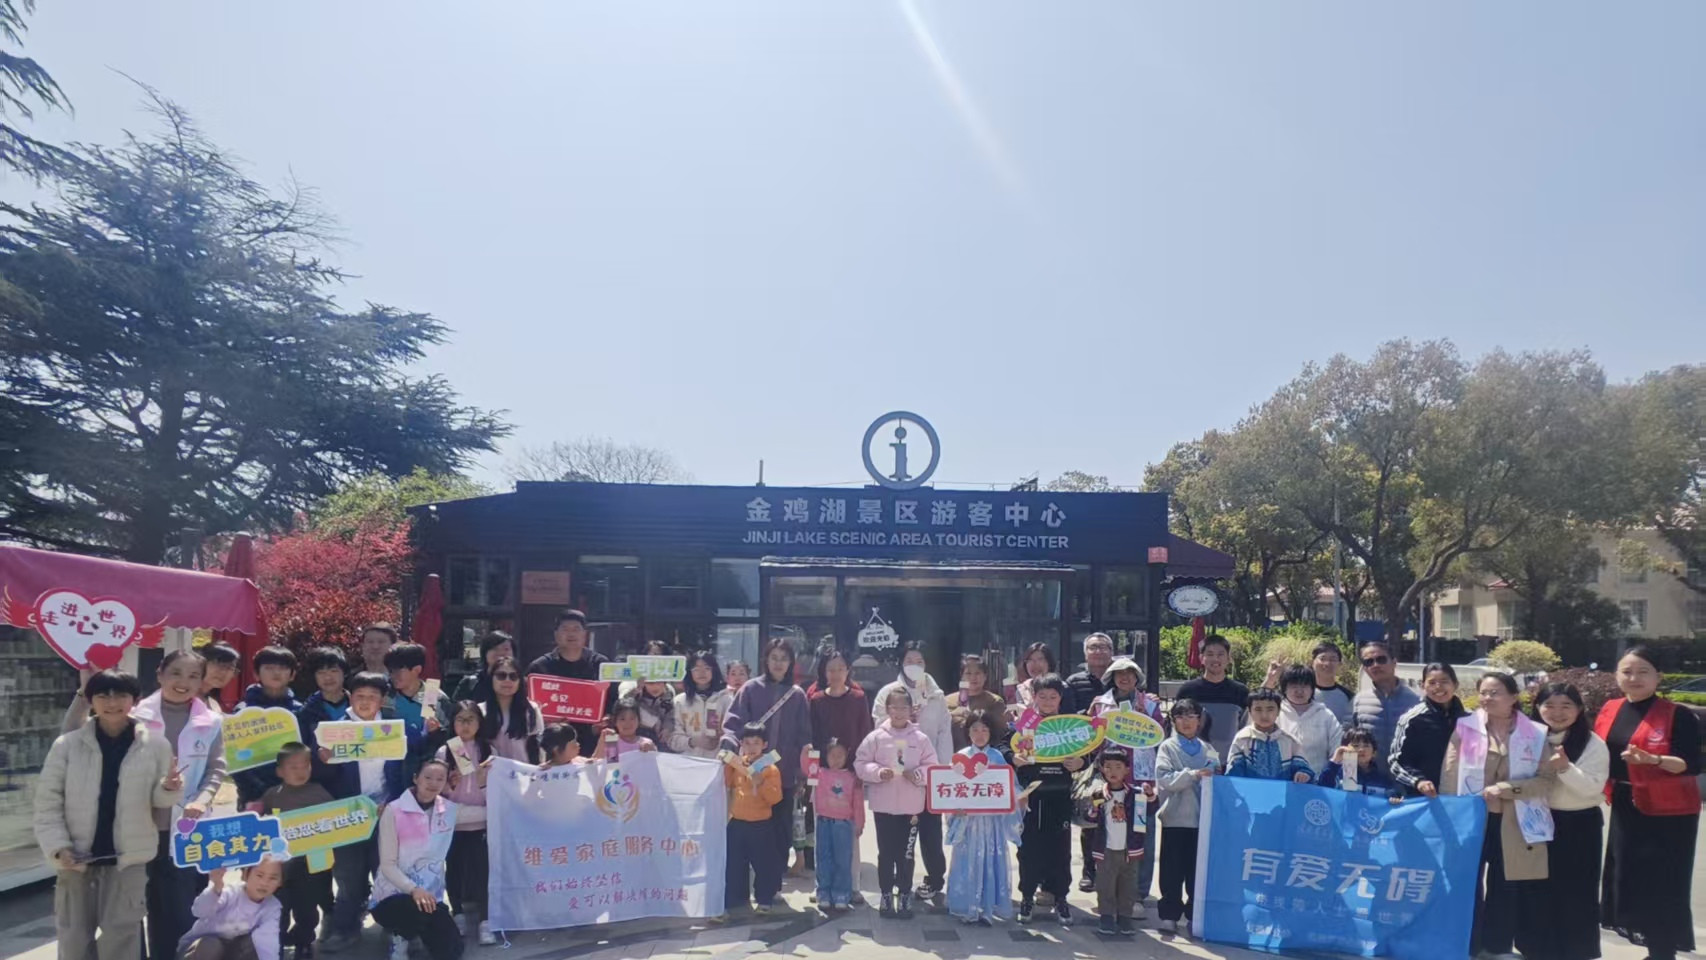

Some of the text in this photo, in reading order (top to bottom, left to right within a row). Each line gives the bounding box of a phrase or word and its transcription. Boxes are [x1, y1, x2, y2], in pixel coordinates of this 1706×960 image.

[745, 496, 1067, 528] 金鸡湖景区游客中心
[742, 530, 1069, 549] JINJI LAKE SCENIC AREA TOURIST CENTER
[936, 782, 1005, 798] 有爱无障
[208, 821, 241, 838] 我想
[184, 832, 271, 863] 自食其力
[523, 836, 700, 867] 维爱家庭服务中心
[1241, 847, 1436, 904] 有爱无碍
